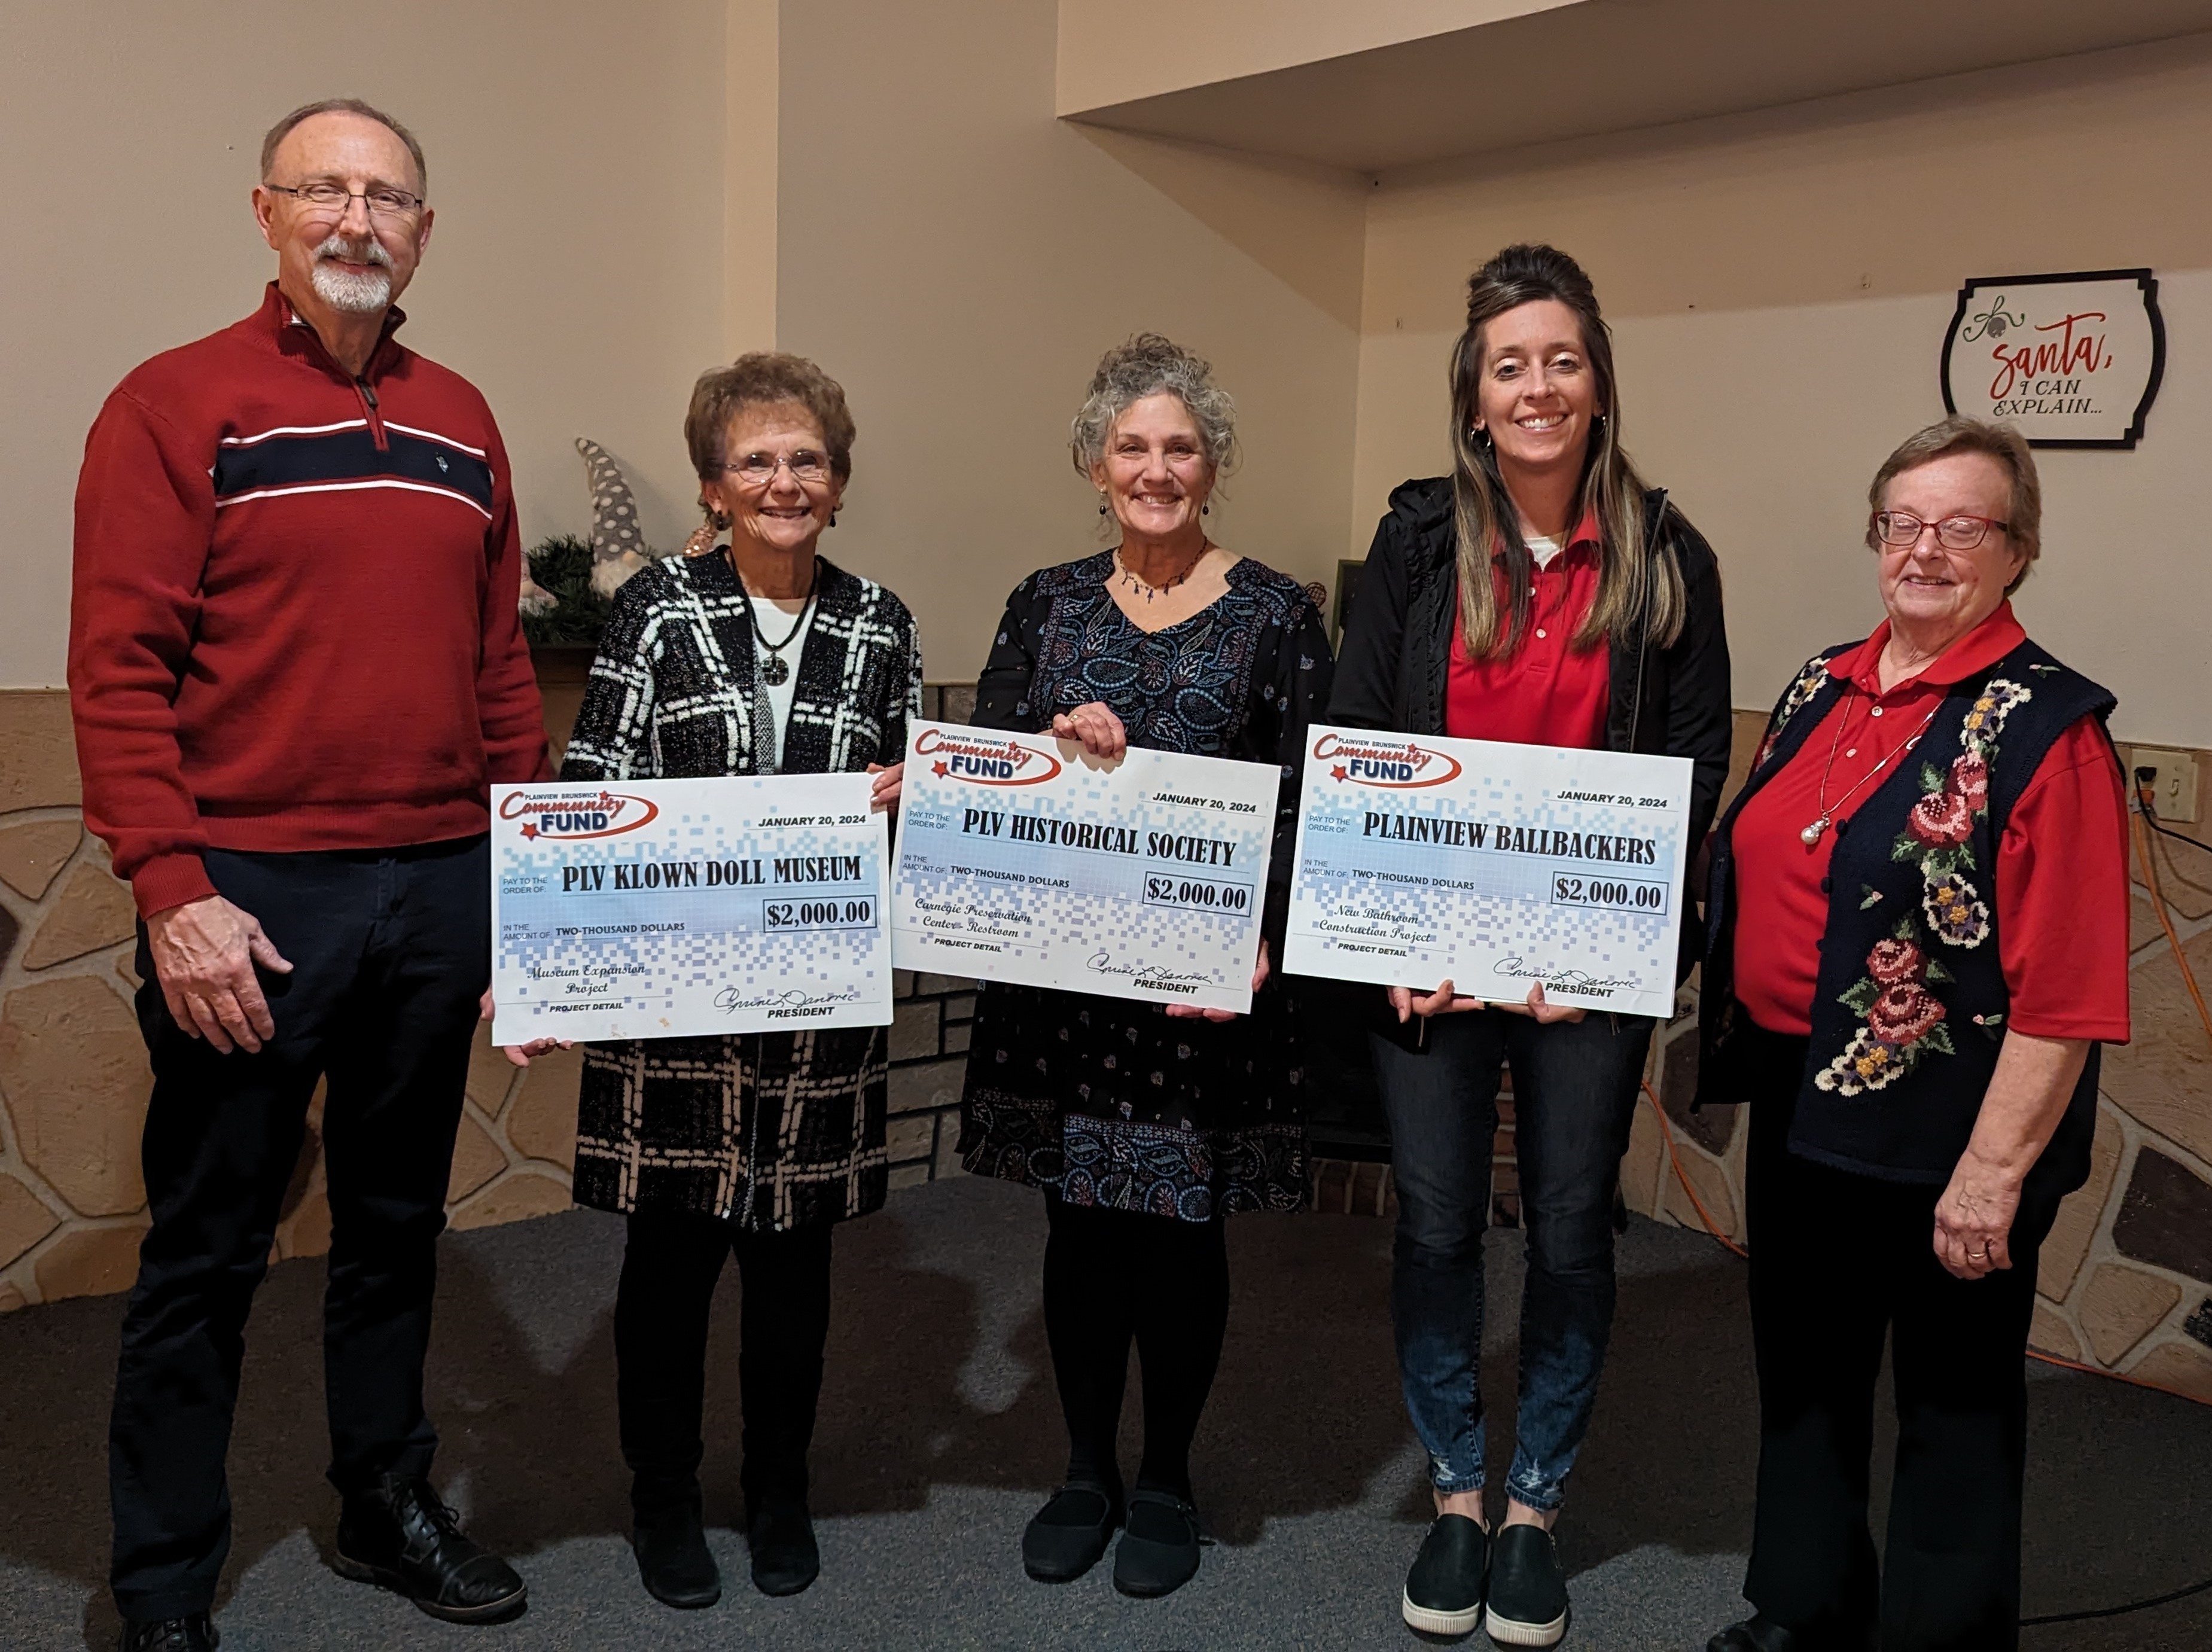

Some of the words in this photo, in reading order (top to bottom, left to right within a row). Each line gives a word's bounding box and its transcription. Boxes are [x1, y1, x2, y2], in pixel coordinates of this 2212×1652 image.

[2019, 381, 2029, 395] I
[2035, 380, 2081, 395] CAN
[915, 729, 1032, 770] Community
[940, 733, 971, 743] PLAINVIEW
[974, 737, 1007, 748] BRUNSWICK
[1338, 737, 1369, 746] PLAINVIEW
[1372, 741, 1406, 750] BRUNSWICK
[1314, 733, 1433, 773] Community
[950, 755, 1014, 779] FUND
[1349, 758, 1413, 781] FUND
[499, 791, 626, 820] Community
[1152, 793, 1208, 806] JANUARY
[1209, 799, 1226, 811] 20,
[1229, 802, 1257, 813] 2024
[1557, 790, 1615, 803] JANUARY
[1617, 796, 1635, 807] 20,
[1638, 798, 1668, 808] 2024
[541, 812, 608, 831] FUND
[758, 817, 815, 827] JANUARY
[818, 816, 834, 826] 20,
[839, 815, 866, 824] 2024
[908, 819, 934, 828] ORDER
[1308, 824, 1334, 833] ORDER
[962, 808, 1005, 838] PLV
[1010, 814, 1139, 855] HISTORICAL
[1147, 831, 1237, 867] SOCIETY
[1363, 812, 1489, 849] PLAINVIEW
[1494, 825, 1656, 865] BALLBACKERS
[562, 865, 606, 892] PLV
[614, 862, 697, 890] KLOWN
[706, 859, 766, 886] DOLL
[773, 855, 861, 883] MUSEUM
[903, 863, 934, 873] AMOUNT
[935, 867, 947, 875] OF:
[950, 865, 1025, 882] TWO-THOUSAND
[1028, 876, 1070, 889] DOLLARS
[1303, 868, 1335, 877] AMOUNT
[1352, 869, 1429, 885] TWO-THOUSAND
[1432, 878, 1474, 890] DOLLARS
[1147, 877, 1247, 910] $2,000.00
[1556, 877, 1661, 908] $2,000.00
[767, 901, 870, 927] $2,000.00
[915, 898, 962, 916] Carnegie
[964, 904, 1032, 923] Preservation
[1334, 905, 1360, 916] New
[1363, 908, 1418, 924] Bathroom
[556, 925, 638, 936] TWO-THOUSAND
[641, 923, 685, 932] DOLLARS
[923, 916, 958, 929] Center
[967, 921, 1019, 938] Restroom
[1319, 919, 1387, 937] Construction
[1390, 928, 1431, 943] Project
[934, 938, 973, 949] PROJECT
[973, 943, 1002, 953] DETAIL
[1337, 943, 1376, 953] PROJECT
[1378, 947, 1407, 957] DETAIL
[527, 967, 580, 979] Museum
[583, 965, 645, 979] Expansion
[565, 983, 609, 996] Project
[1133, 979, 1199, 994] PRESIDENT
[1545, 982, 1614, 998] PRESIDENT
[549, 1004, 591, 1013] PROJECT
[592, 1002, 623, 1011] DETAIL
[767, 1007, 835, 1018] PRESIDENT
